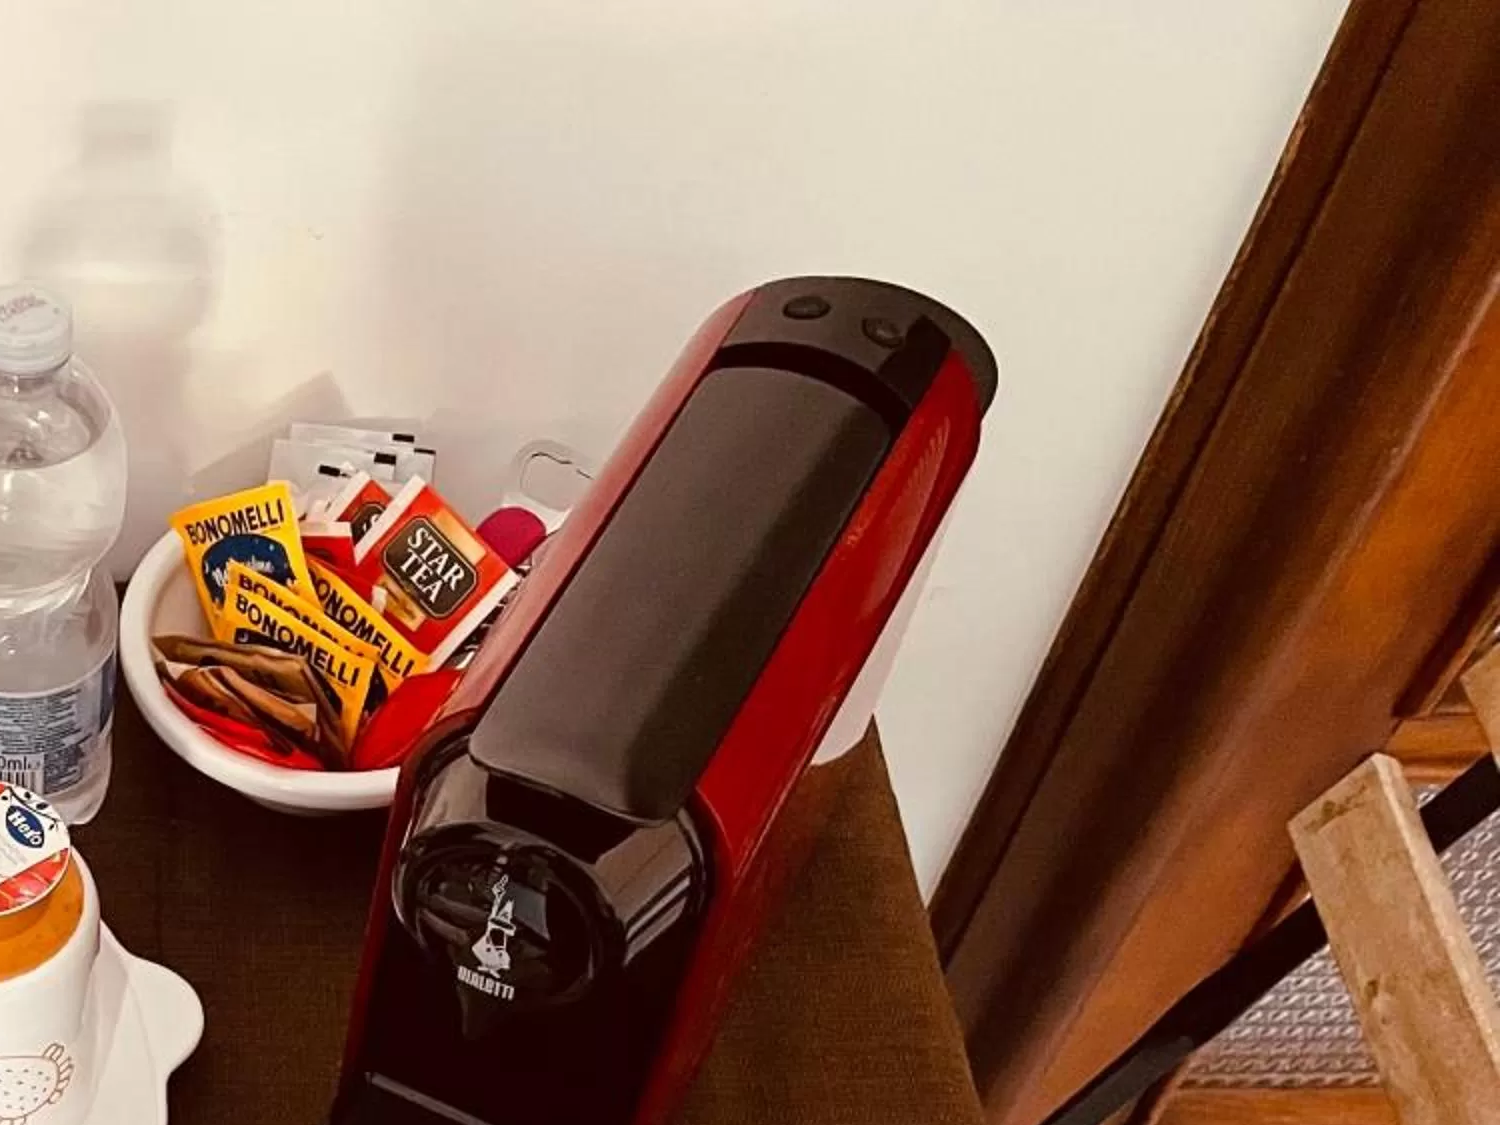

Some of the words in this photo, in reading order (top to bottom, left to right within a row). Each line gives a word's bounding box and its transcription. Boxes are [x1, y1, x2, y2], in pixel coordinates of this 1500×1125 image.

[184, 498, 285, 546] BONOMELLI
[400, 548, 444, 604] TEA
[407, 527, 465, 591] STAR
[236, 594, 360, 687] BONOMELLI
[308, 567, 415, 678] ONOMELLI
[7, 810, 43, 846] Hero
